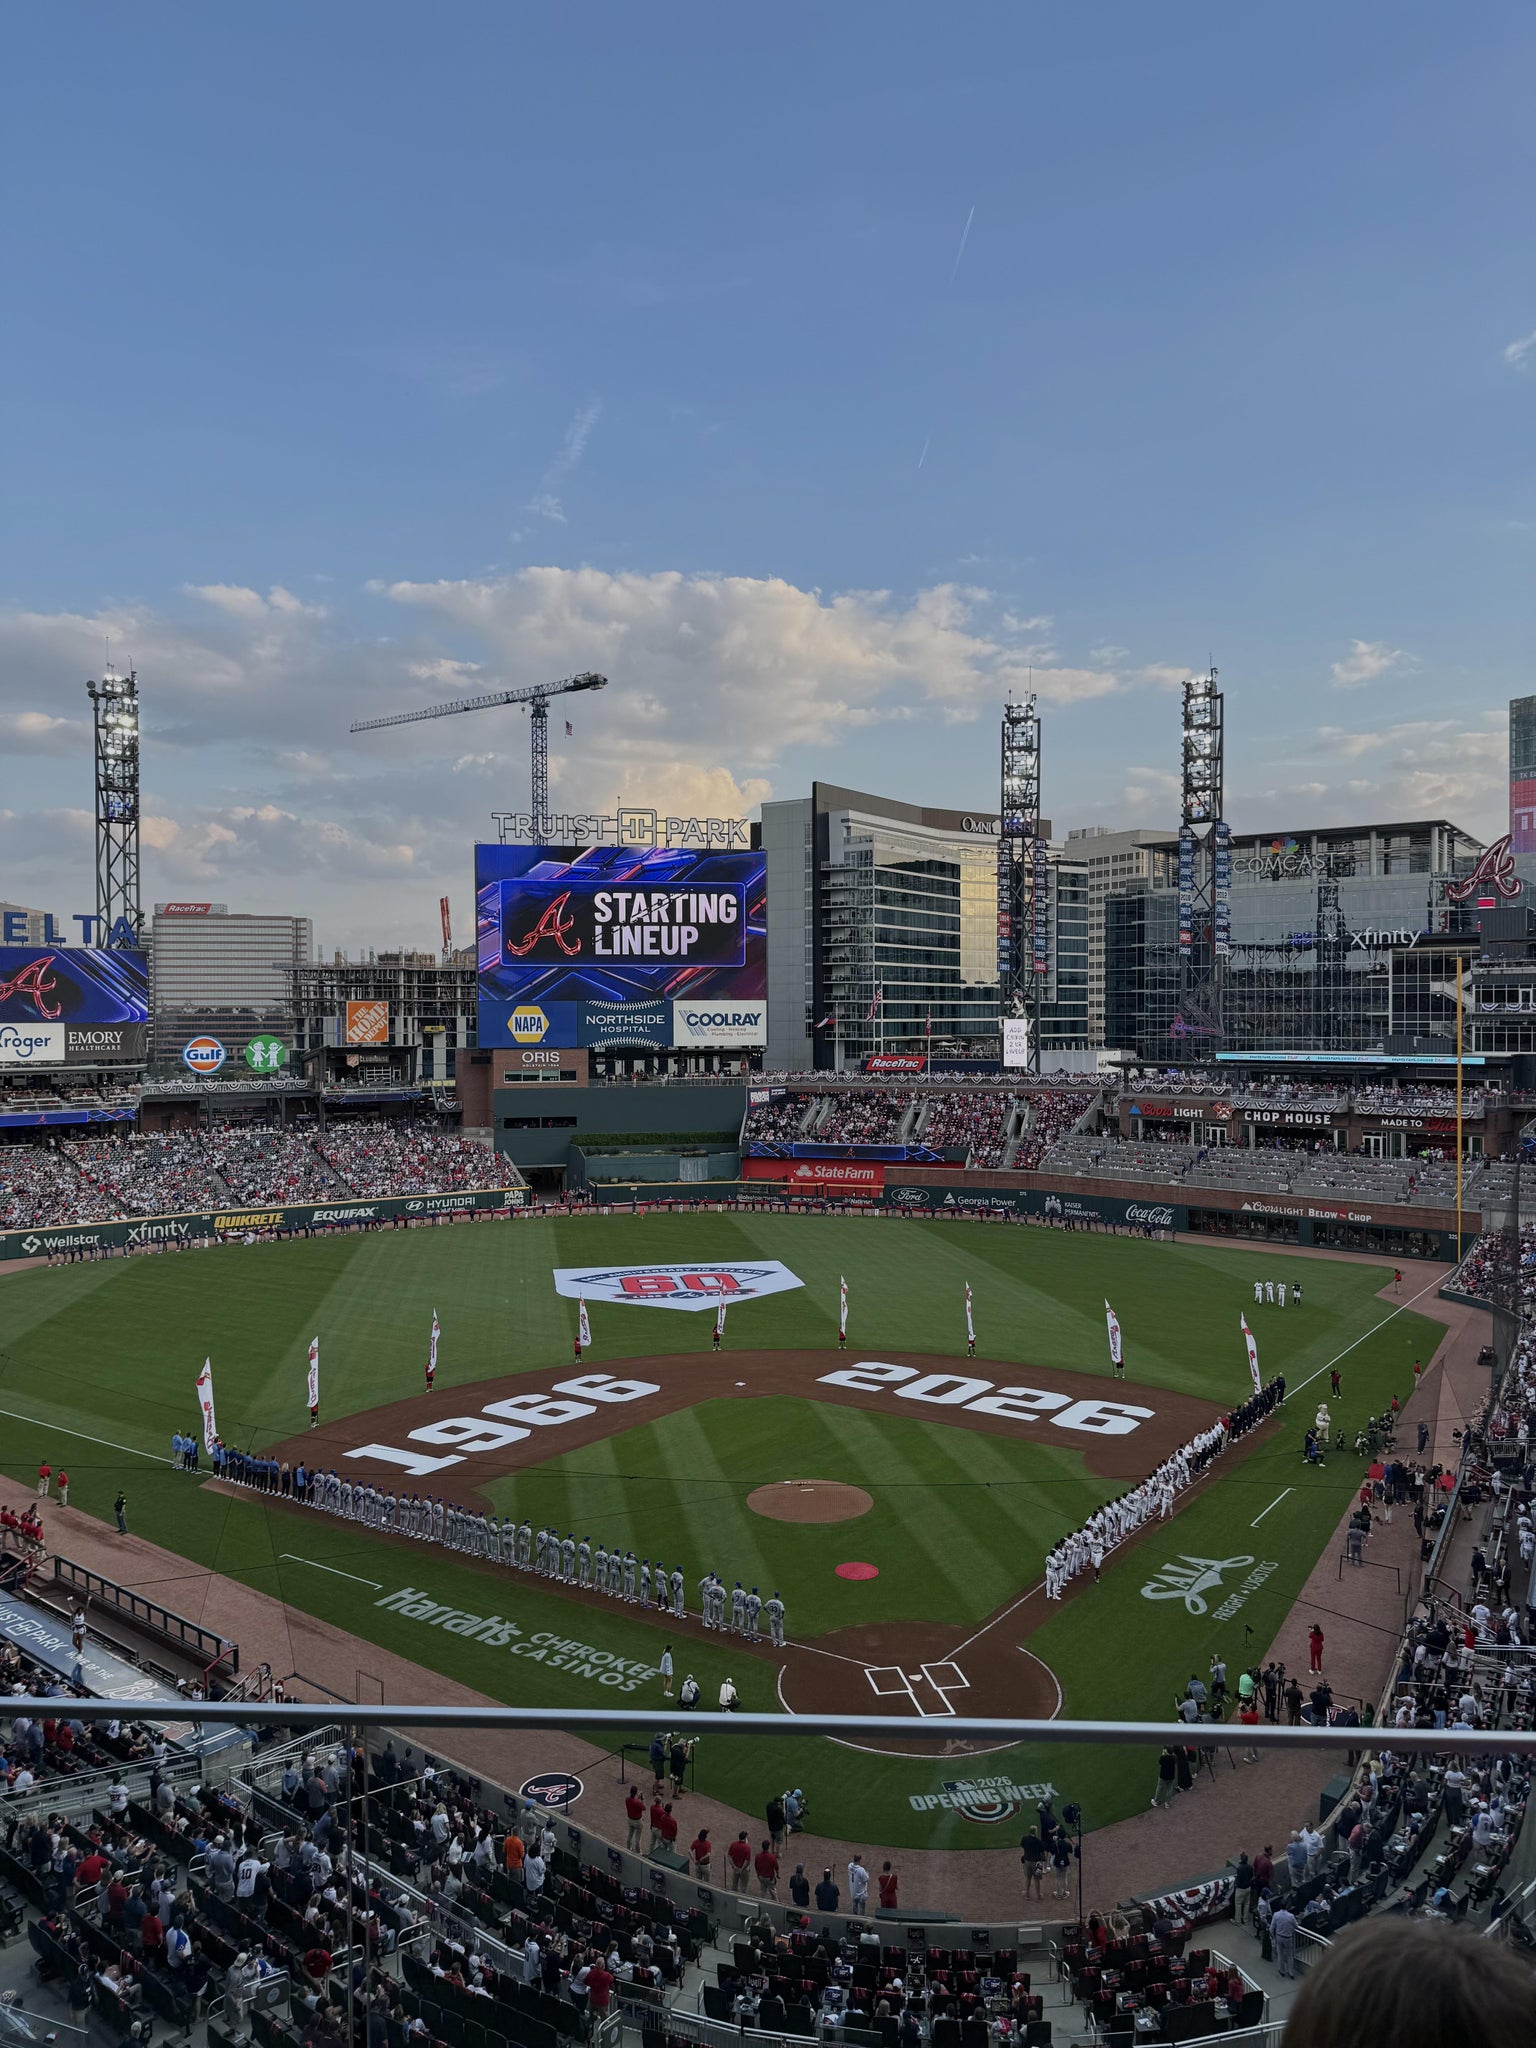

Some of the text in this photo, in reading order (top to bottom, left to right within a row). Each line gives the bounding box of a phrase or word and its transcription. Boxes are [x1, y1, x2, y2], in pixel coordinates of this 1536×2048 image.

[491, 812, 748, 843] TRUIST PARK
[962, 816, 992, 834] OMNI
[1233, 852, 1339, 874] COMCAST
[594, 892, 738, 924] STARTING
[594, 925, 699, 956] LINEUP
[1351, 926, 1422, 950] xfinity
[351, 1005, 369, 1022] THE
[586, 1015, 666, 1025] NORTHSIDE
[686, 1012, 762, 1027] COOLRAY
[347, 1002, 388, 1041] HOME
[363, 1015, 388, 1041] DEPOT
[514, 1016, 543, 1032] NAPA
[68, 1031, 123, 1045] EMORY
[186, 1049, 222, 1060] Gulf
[522, 1051, 560, 1063] ORIS
[872, 1058, 919, 1068] RaceTrac
[1141, 1103, 1203, 1118] Coors LIGHT
[1244, 1111, 1331, 1125] CHOP HOUSE
[1381, 1118, 1408, 1127] MADE
[1411, 1119, 1422, 1127] TO
[504, 1191, 524, 1199] PAPA
[504, 1198, 524, 1206] JOHNS
[898, 1188, 922, 1201] Ford
[957, 1196, 1016, 1208] Georgia Power
[427, 1197, 475, 1209] HYUNDAI
[312, 1207, 375, 1222] EQUIFAX
[1126, 1204, 1175, 1225] Coca-Cola
[1252, 1201, 1278, 1213] Coors
[1279, 1207, 1304, 1216] LIGHT
[1308, 1208, 1338, 1219] BELOW
[1348, 1212, 1372, 1223] CHOP
[214, 1213, 284, 1228] QUIKRETE
[44, 1234, 100, 1249] Wellstar
[619, 1272, 742, 1293] 60
[815, 1361, 1156, 1435] 2026
[342, 1374, 661, 1476] 1966
[1211, 1593, 1249, 1622] FREIGHT
[1245, 1560, 1280, 1590] LOGISTICS
[26, 1630, 69, 1651] PARK
[530, 1632, 661, 1681] CHEROKEE
[94, 1667, 115, 1680] THE
[510, 1642, 643, 1692] CASINOS
[977, 1776, 1012, 1788] 2026
[909, 1782, 1060, 1811] OPENING WEEK
[241, 1868, 252, 1880] 10
